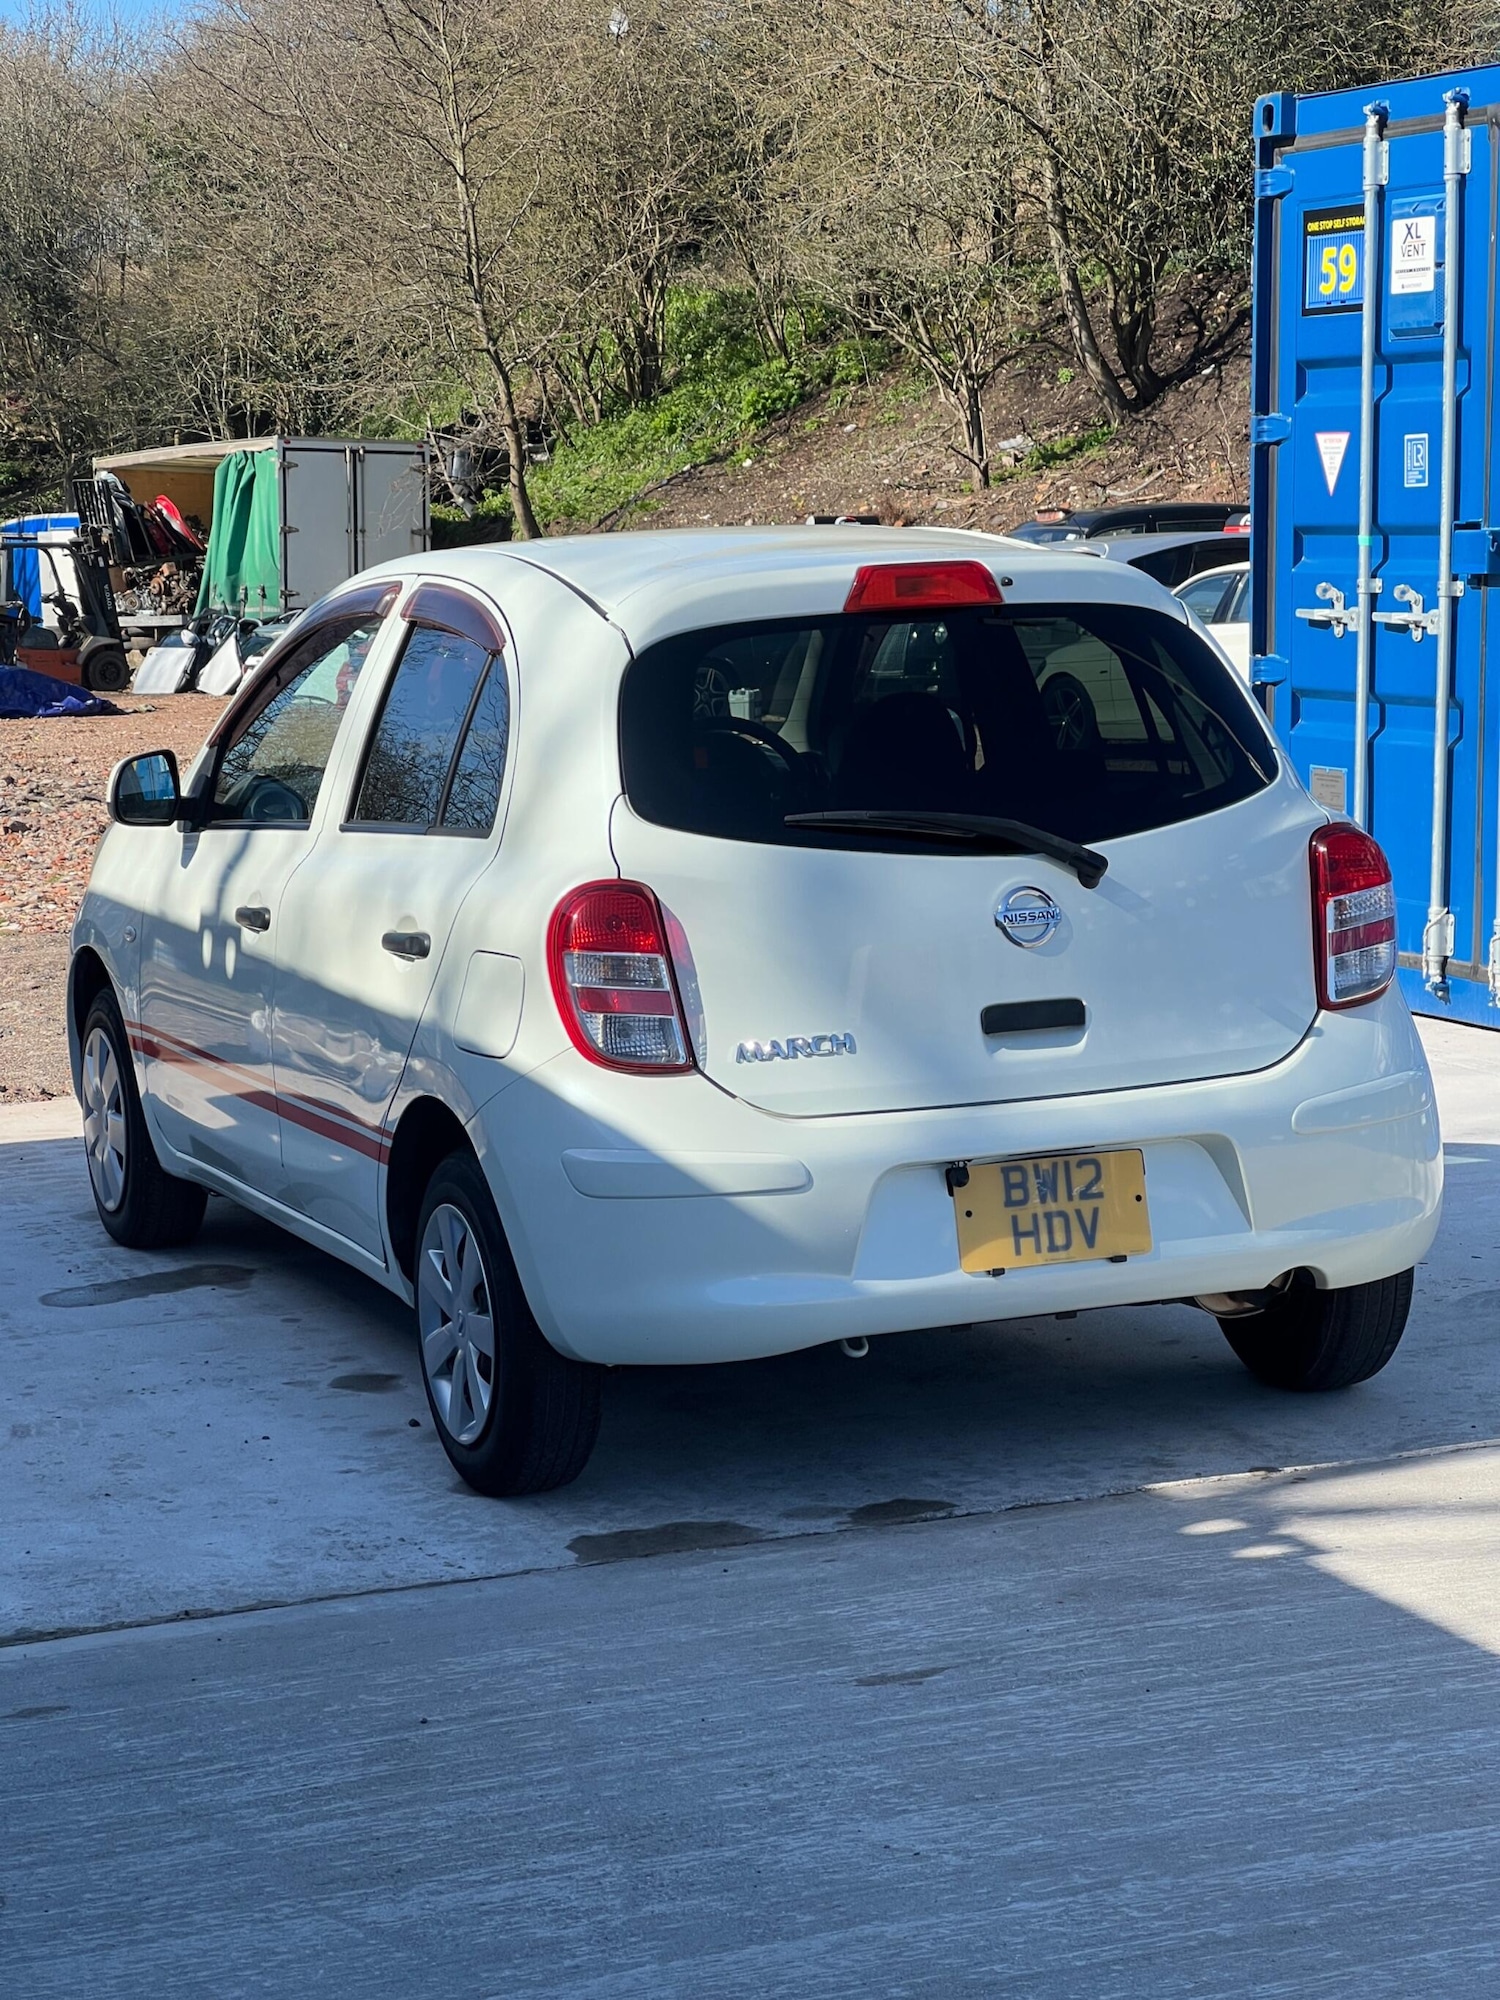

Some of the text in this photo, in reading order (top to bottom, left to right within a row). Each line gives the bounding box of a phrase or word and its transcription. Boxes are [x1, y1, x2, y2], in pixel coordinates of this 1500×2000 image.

[1307, 215, 1366, 232] ONE STOP SELF STORA
[1403, 222, 1421, 244] XL
[1401, 243, 1426, 258] VENT
[1319, 243, 1357, 294] 59
[104, 584, 112, 610] TOYOTA
[1003, 910, 1056, 923] NISSAN
[736, 1033, 857, 1065] MARCH
[1000, 1157, 1105, 1208] BW12
[1011, 1206, 1100, 1256] HDV
